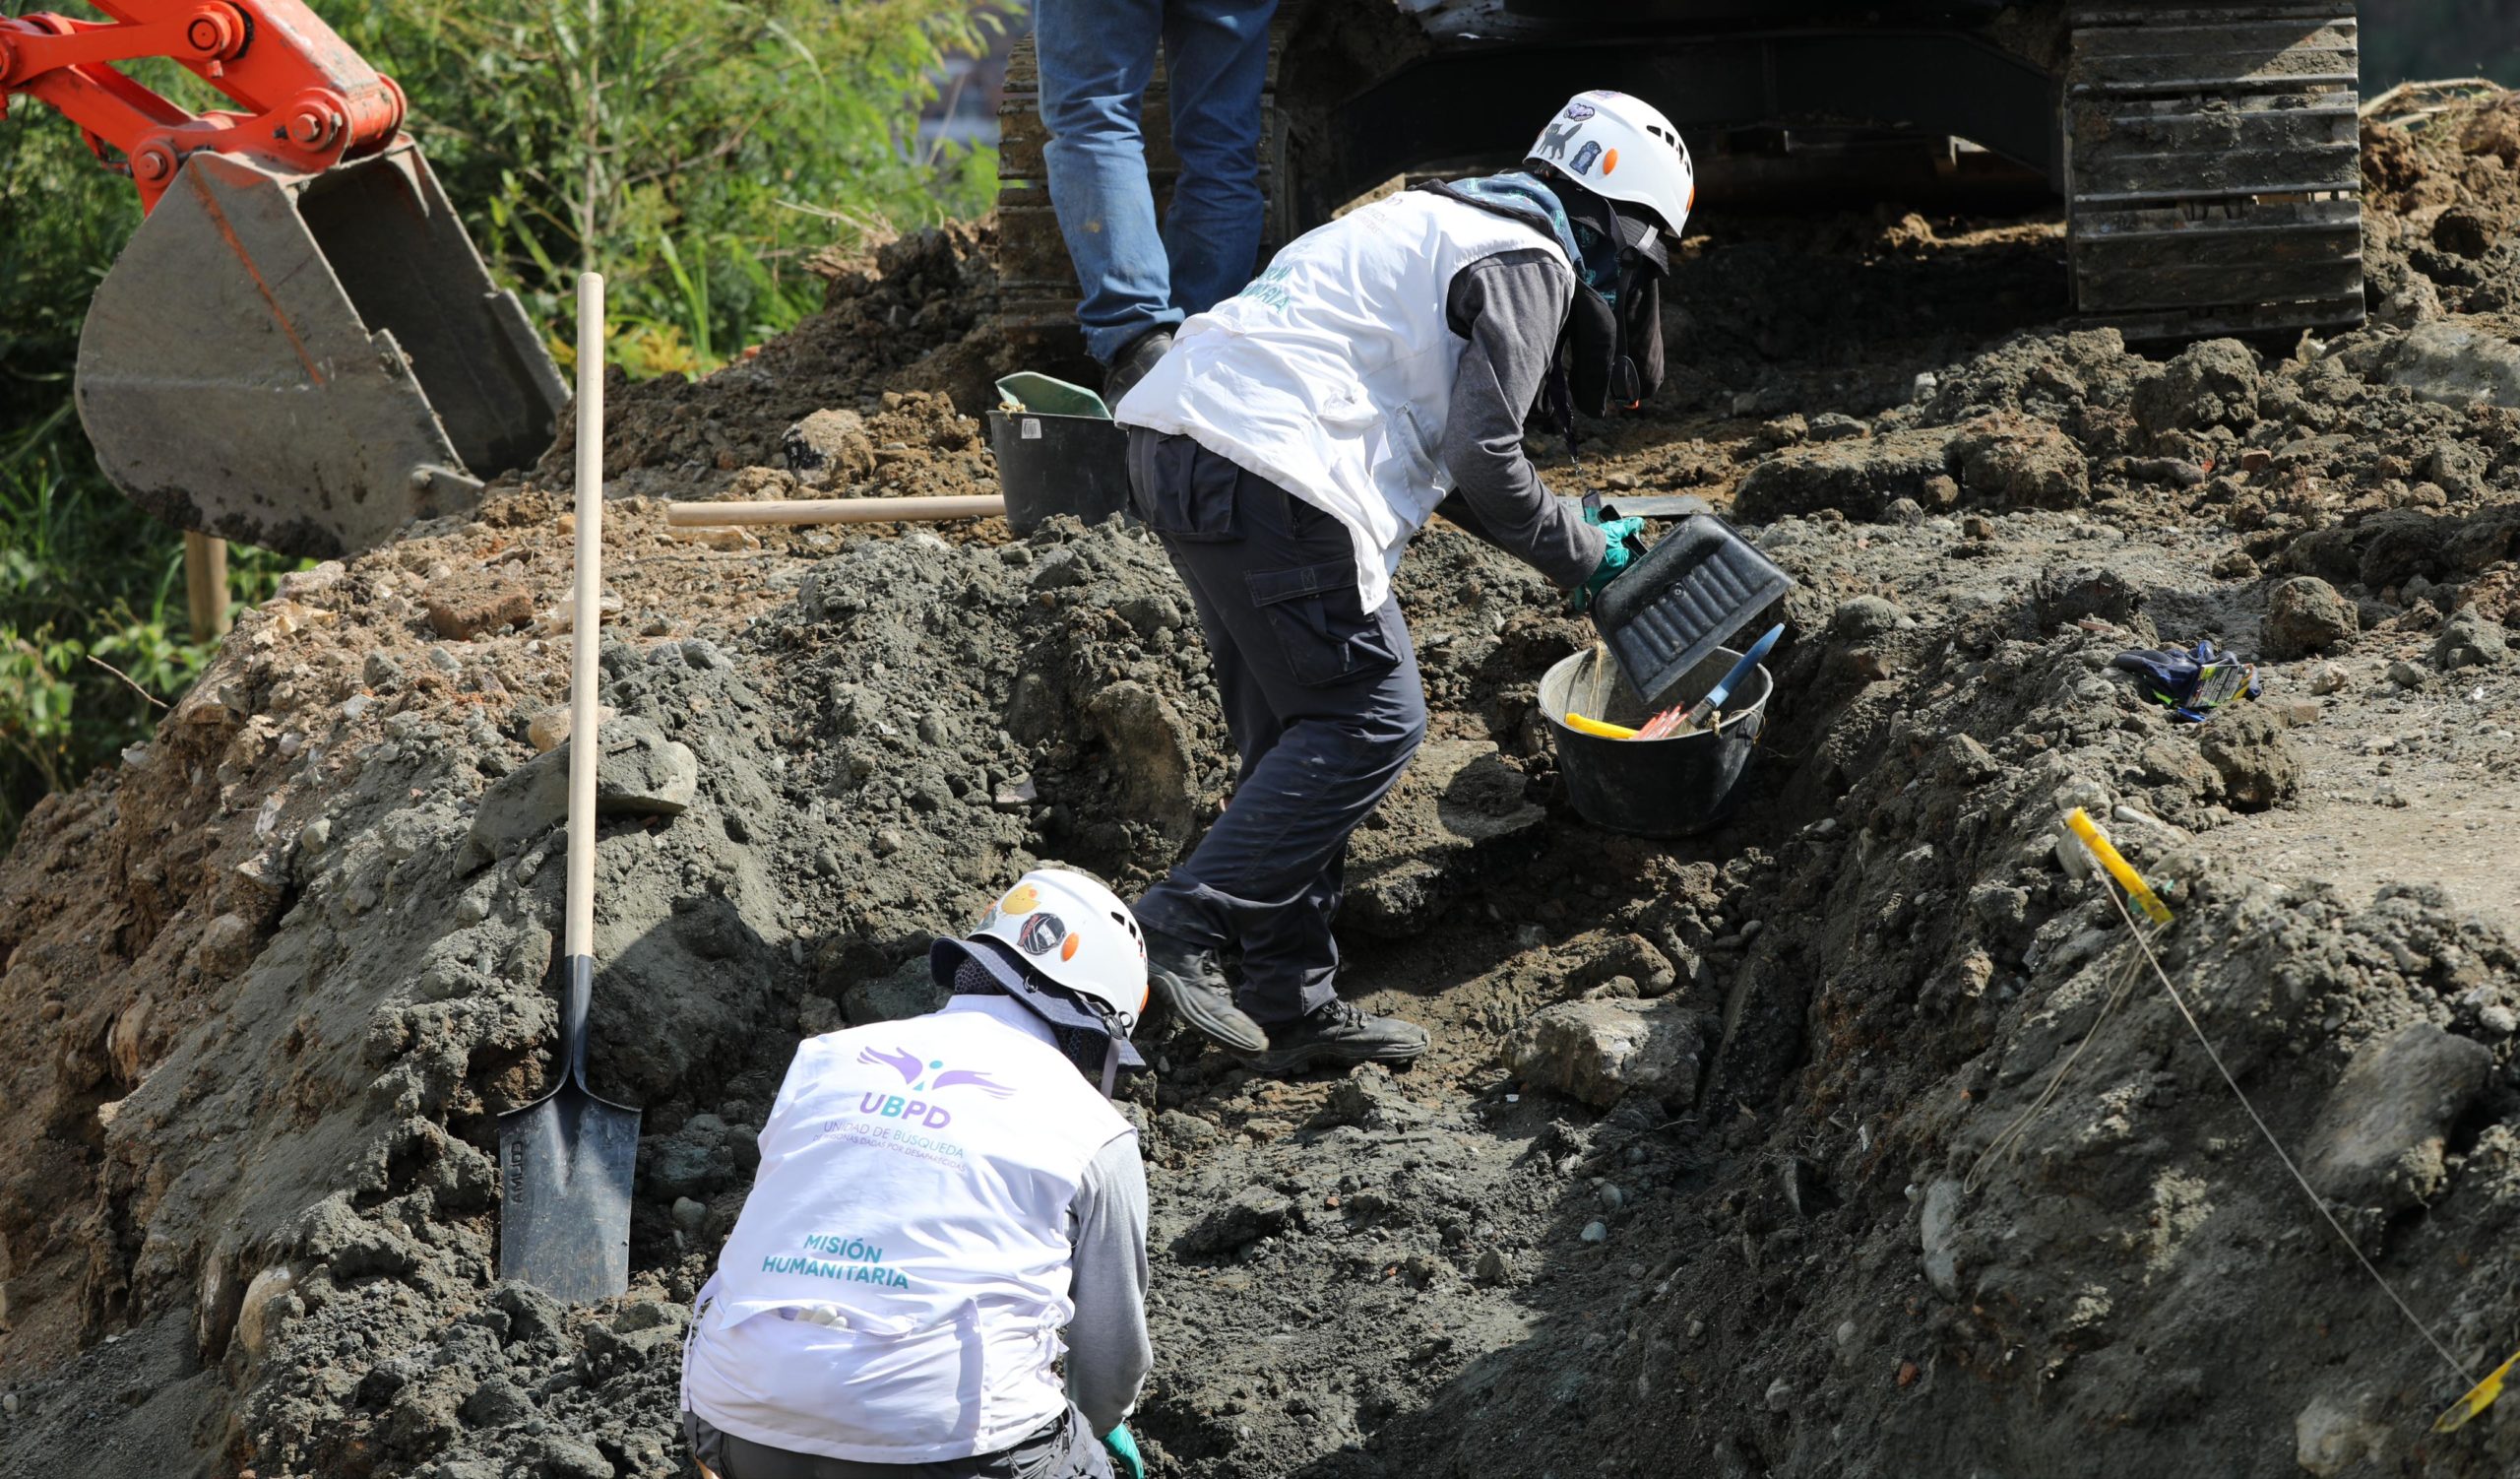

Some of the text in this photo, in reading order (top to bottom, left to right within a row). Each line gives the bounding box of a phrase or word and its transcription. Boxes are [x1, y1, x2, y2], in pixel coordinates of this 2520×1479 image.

[860, 1092, 951, 1128] UBPD
[823, 1120, 870, 1135] UNIDAD
[872, 1125, 892, 1139] DE
[803, 1235, 883, 1263] MISIÓN
[762, 1256, 909, 1289] HUMANITARIA
